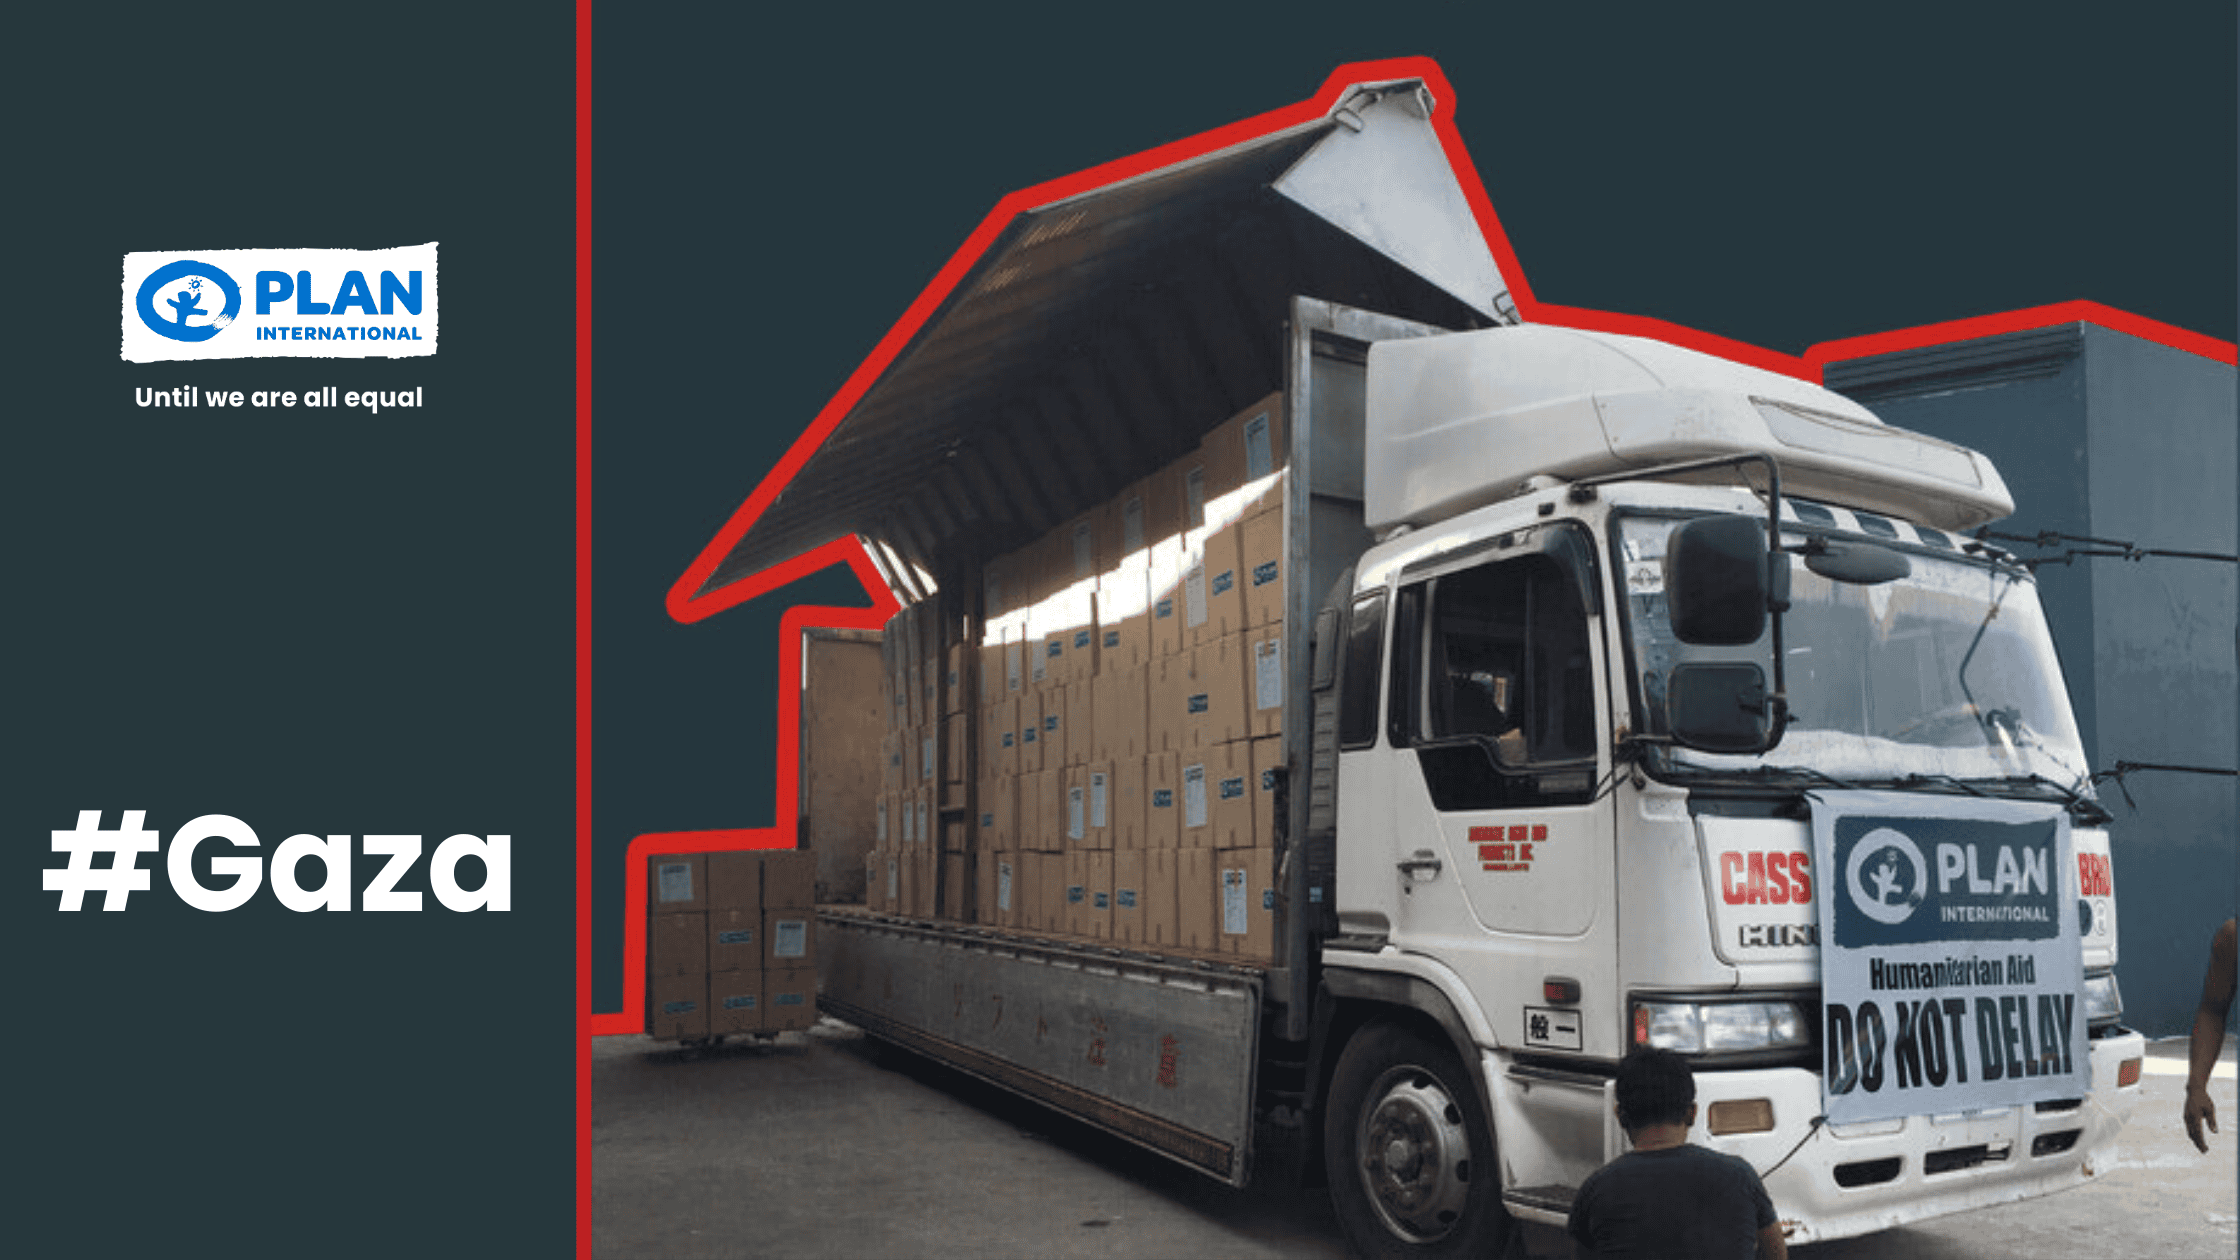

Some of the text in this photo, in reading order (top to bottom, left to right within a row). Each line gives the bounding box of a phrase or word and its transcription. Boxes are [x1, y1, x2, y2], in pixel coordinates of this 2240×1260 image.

[1720, 851, 1812, 905] CASS
[1937, 843, 2048, 895] PLAN
[1739, 924, 1820, 947] HIN
[1941, 906, 2050, 922] INTERNATIONAL
[1870, 955, 2036, 990] Humanitarian Aid
[1826, 994, 2075, 1095] DO NOT DELAY
